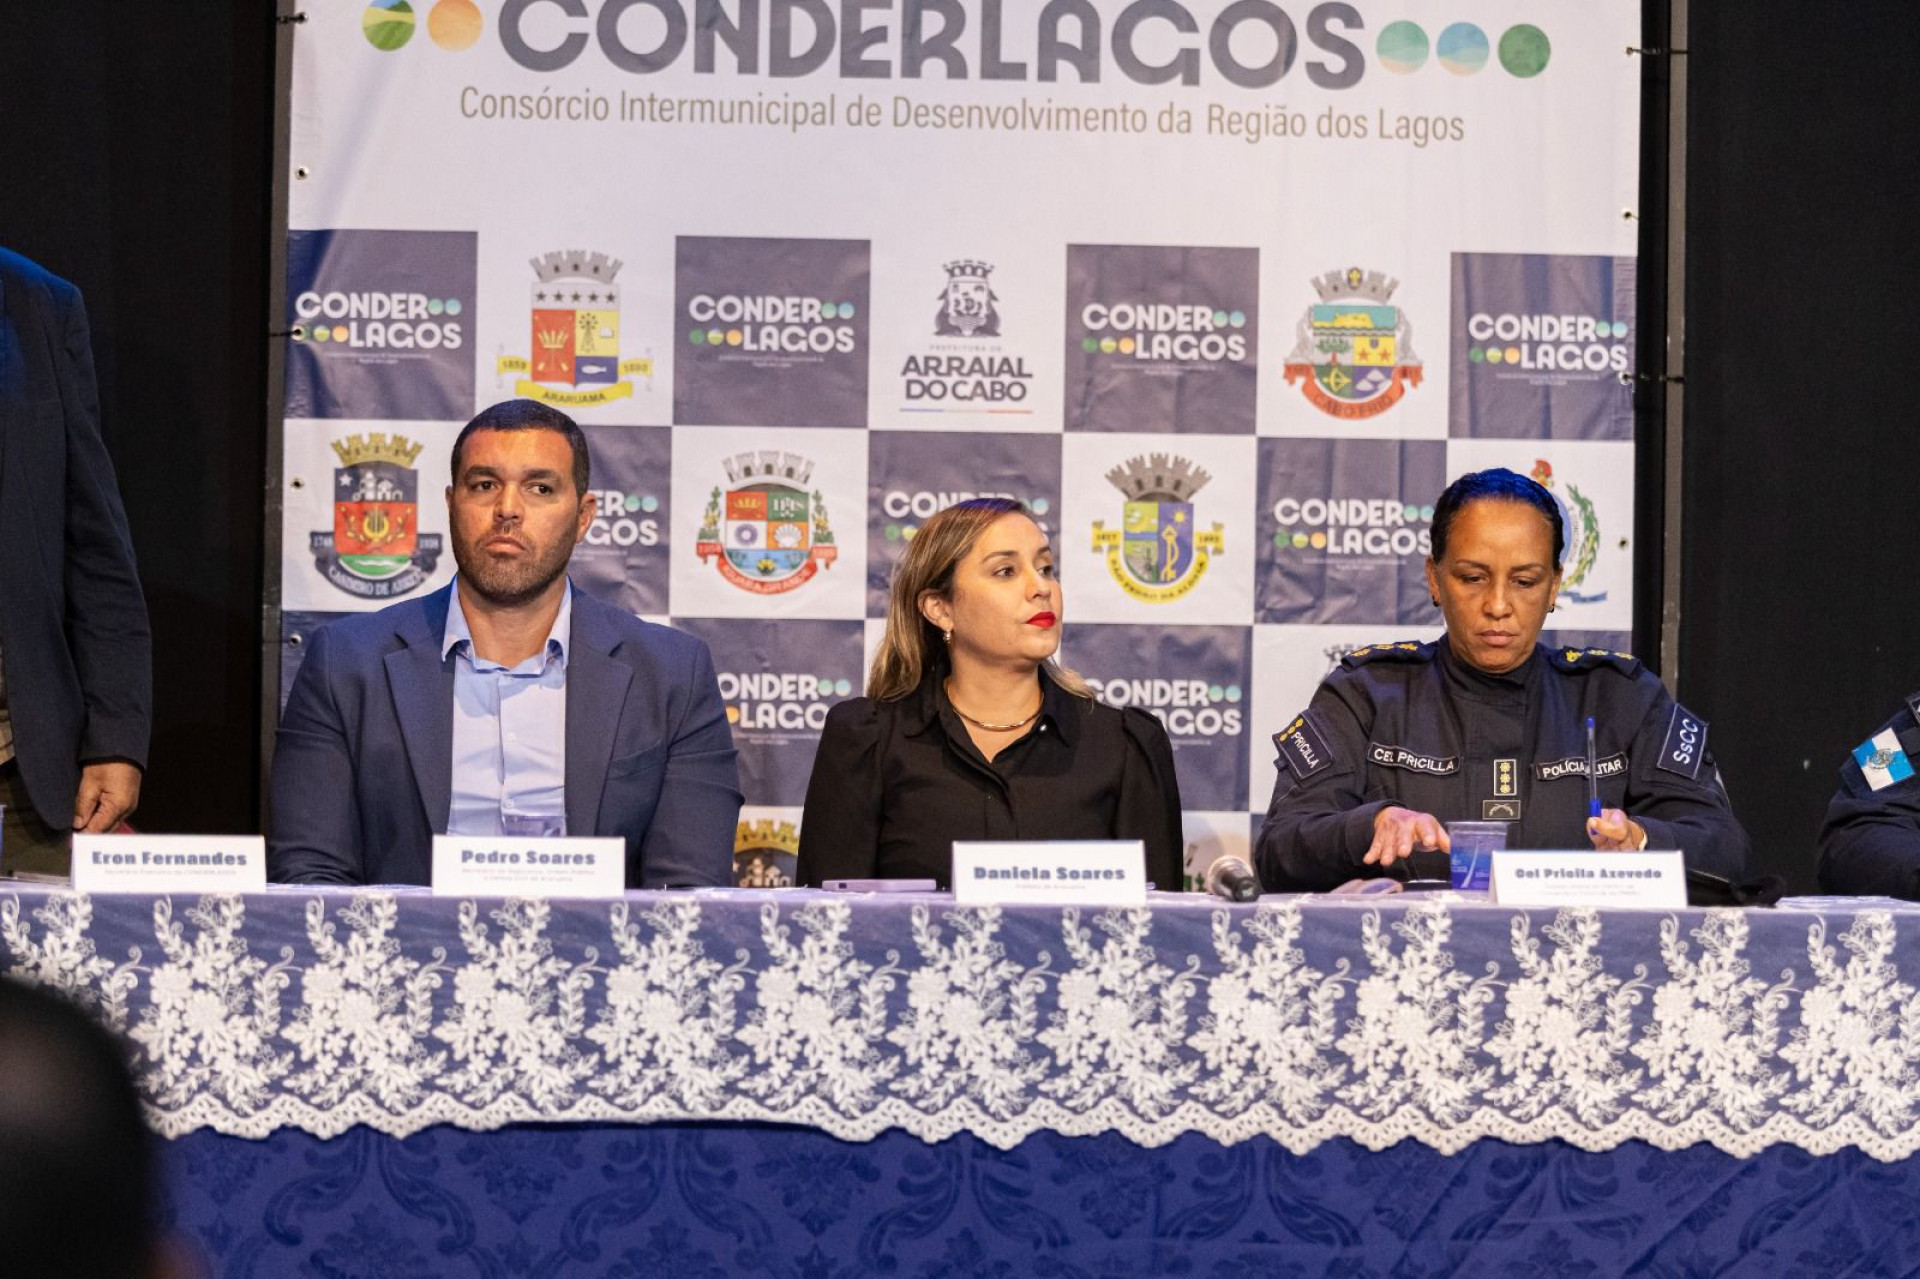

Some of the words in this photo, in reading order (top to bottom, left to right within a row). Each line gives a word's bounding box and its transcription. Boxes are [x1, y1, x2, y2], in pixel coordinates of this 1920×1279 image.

[498, 0, 1366, 90] CONDERLAGOS
[460, 86, 609, 121] Consórcio
[621, 90, 835, 133] Intermunicipal
[846, 95, 881, 127] de
[893, 97, 1148, 133] Desenvolvimento
[1158, 104, 1192, 134] da
[1207, 104, 1306, 144] Região
[1317, 108, 1368, 139] dos
[1379, 108, 1465, 148] Lagos
[295, 291, 429, 320] CONDER
[689, 295, 822, 323] CONDER
[1082, 303, 1214, 332] CONDER
[349, 322, 462, 349] LAGOS
[743, 325, 855, 353] LAGOS
[1468, 313, 1597, 342] CONDER
[1135, 333, 1246, 361] LAGOS
[1521, 343, 1628, 372] LAGOS
[901, 355, 1033, 378] ARRAIAL
[906, 379, 948, 400] DO
[951, 380, 1027, 401] CABO
[883, 491, 1015, 518] CON
[1274, 498, 1405, 526] CONDER
[717, 672, 819, 700] ONDER
[740, 702, 829, 729] LAGO
[1291, 731, 1319, 768] PRICILLA
[1374, 748, 1394, 763] CEL
[1397, 751, 1454, 771] PRICILLA
[92, 851, 136, 865] Eron
[142, 851, 247, 866] Fernandes
[461, 850, 521, 864] Pedro
[526, 851, 596, 866] Soares
[974, 866, 1051, 880] Daniela
[1056, 866, 1126, 880] Soares
[1600, 868, 1662, 879] Azevedo
